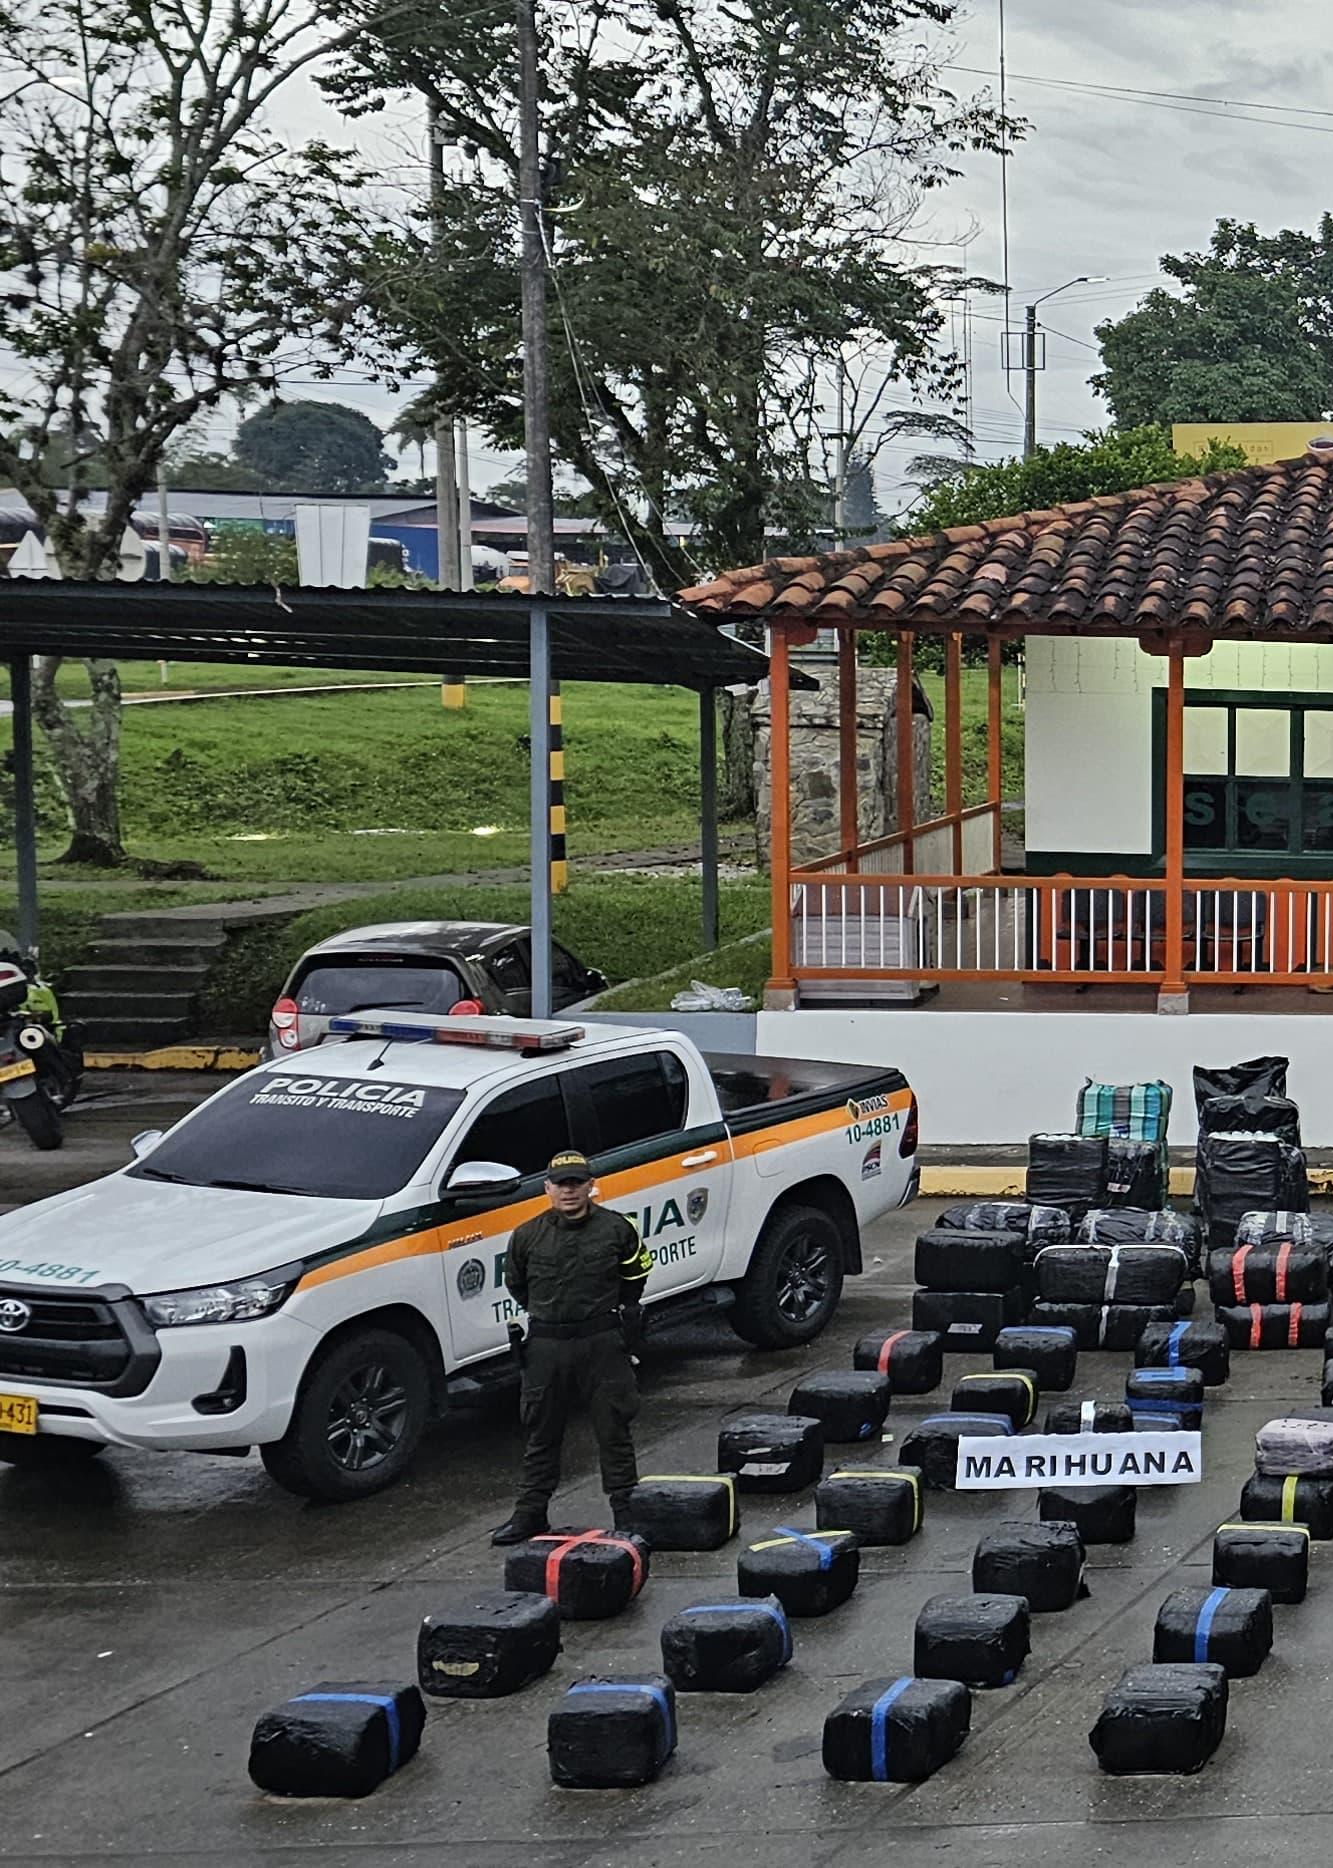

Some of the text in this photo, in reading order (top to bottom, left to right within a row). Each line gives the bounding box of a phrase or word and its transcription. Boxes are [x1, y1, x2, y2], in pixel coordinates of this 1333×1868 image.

[260, 1078, 426, 1107] POLICIA
[860, 1096, 888, 1114] INVIAS
[250, 1094, 421, 1118] TRANSITO Y TRANSPORTE
[845, 1112, 899, 1145] 10-4881
[0, 1258, 101, 1284] 0-4881
[0, 1402, 32, 1425] -431
[965, 1451, 1195, 1478] MARIHUANA
